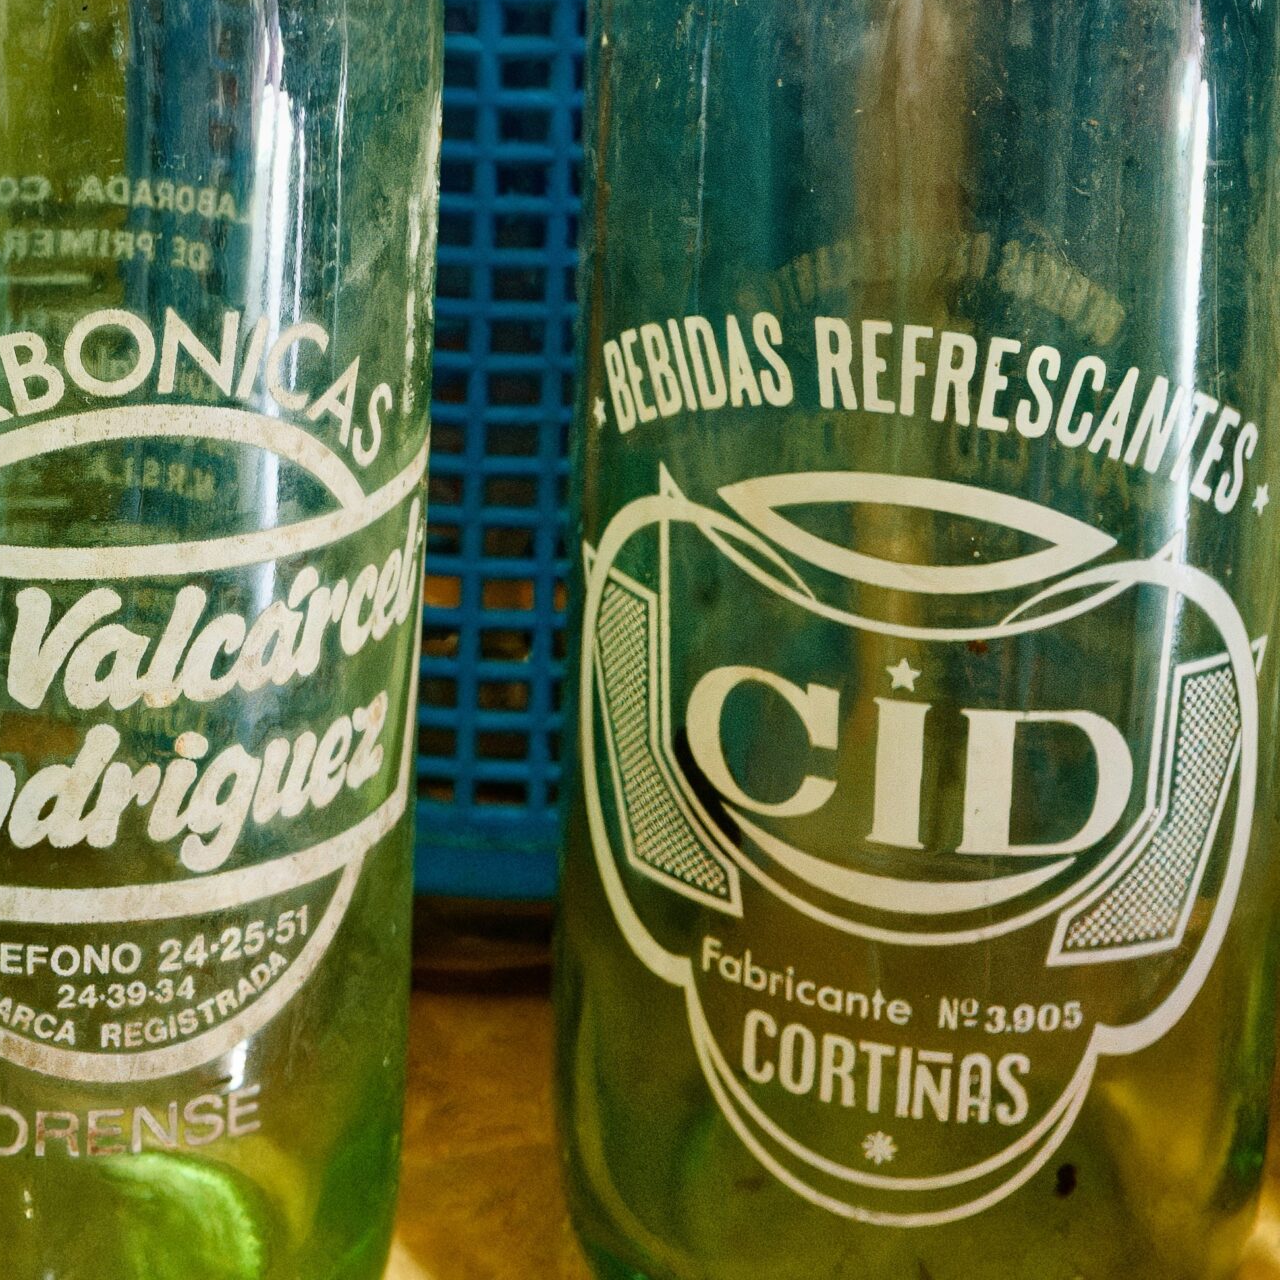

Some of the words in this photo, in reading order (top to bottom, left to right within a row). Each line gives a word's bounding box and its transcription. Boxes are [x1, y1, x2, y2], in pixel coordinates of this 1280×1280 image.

[603, 311, 794, 434] BEBIDAS
[814, 315, 1259, 514] REFRESCANTES
[100, 949, 289, 1049] REGISTRADA
[700, 934, 914, 1026] Fabricante
[983, 1000, 1084, 1035] 3.905
[741, 1008, 1032, 1127] CORTIÑAS
